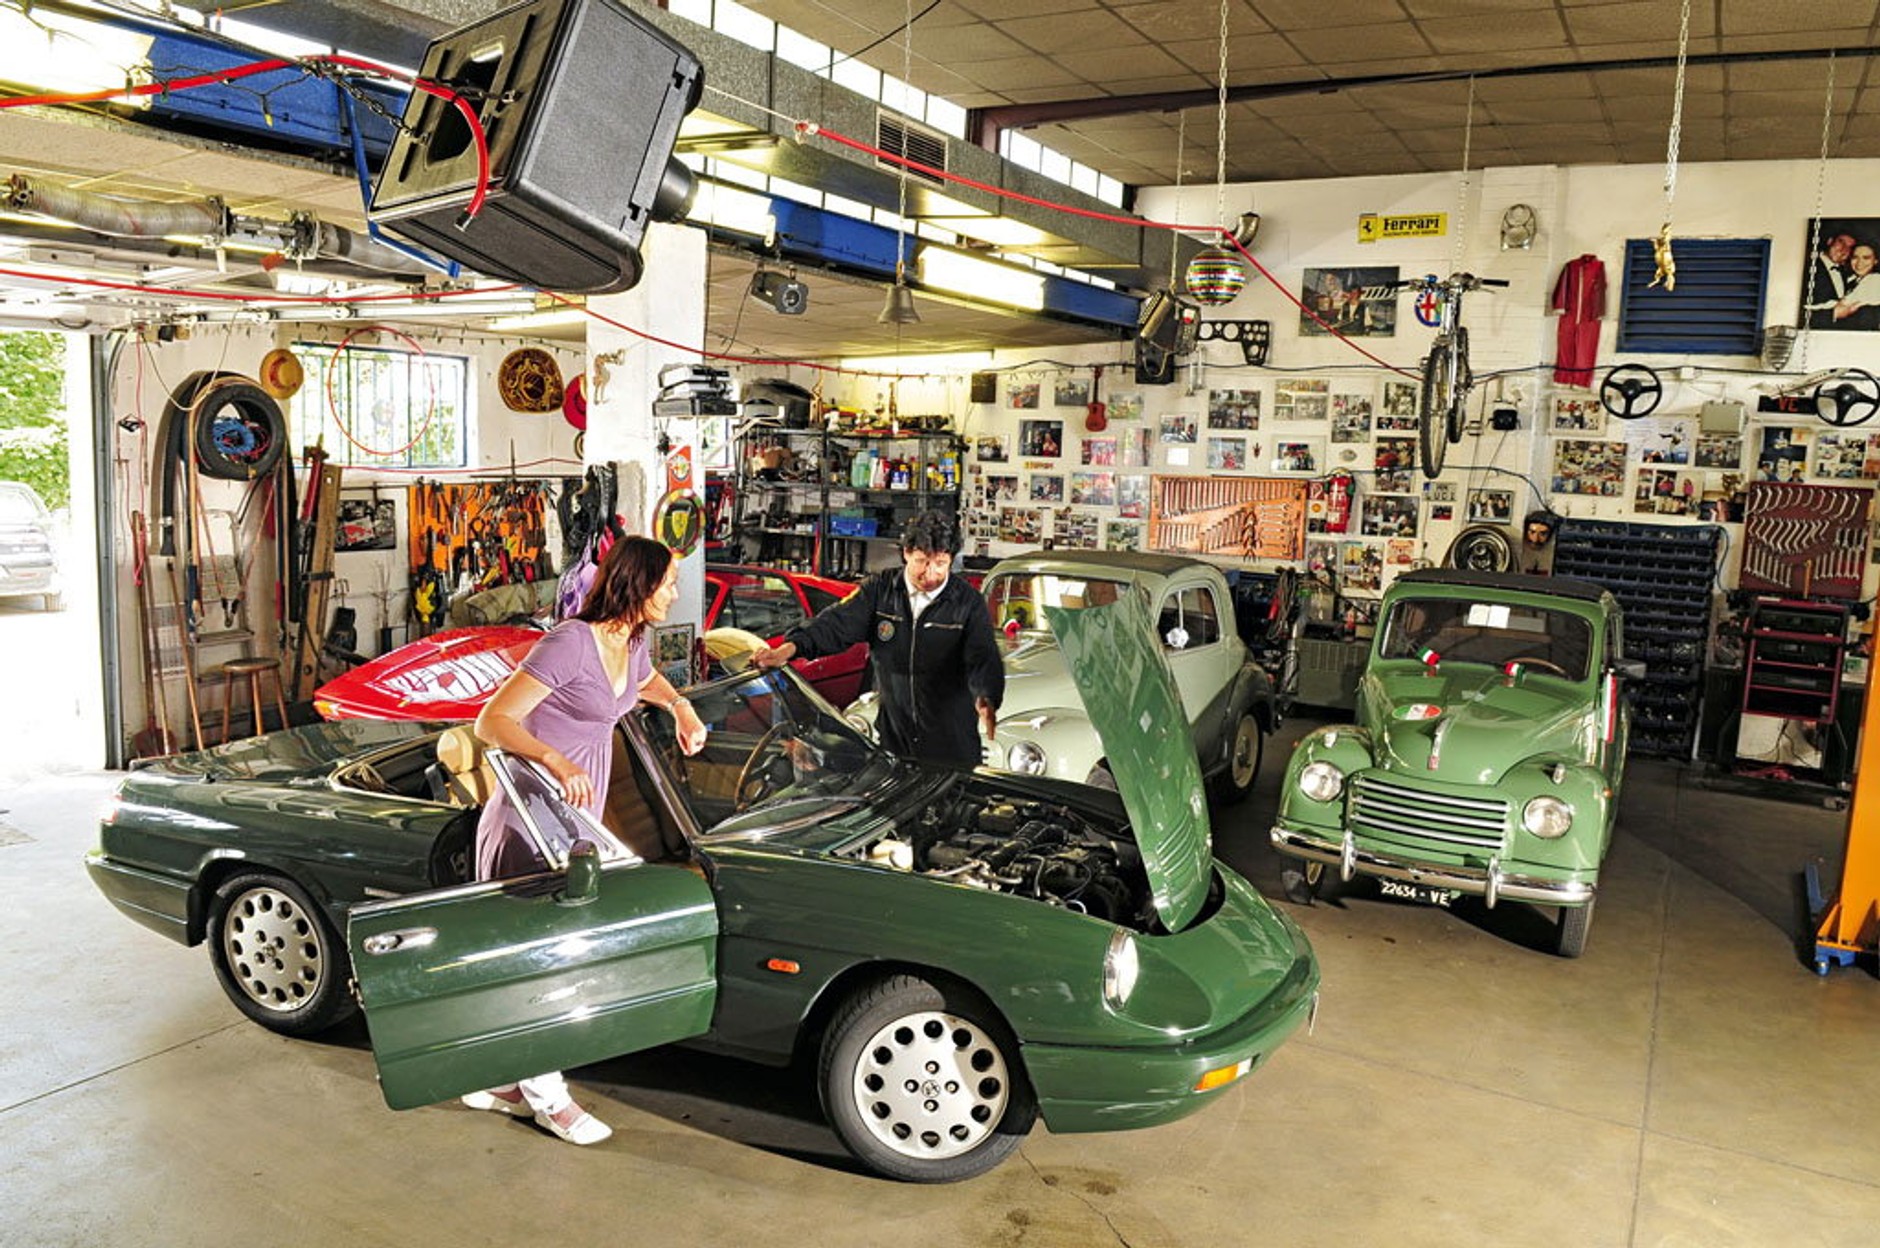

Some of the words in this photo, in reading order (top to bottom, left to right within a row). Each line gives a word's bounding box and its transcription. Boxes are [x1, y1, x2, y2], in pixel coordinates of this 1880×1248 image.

[1383, 218, 1439, 231] Ferrari
[1381, 881, 1416, 898] 22634
[1430, 890, 1450, 907] VE
